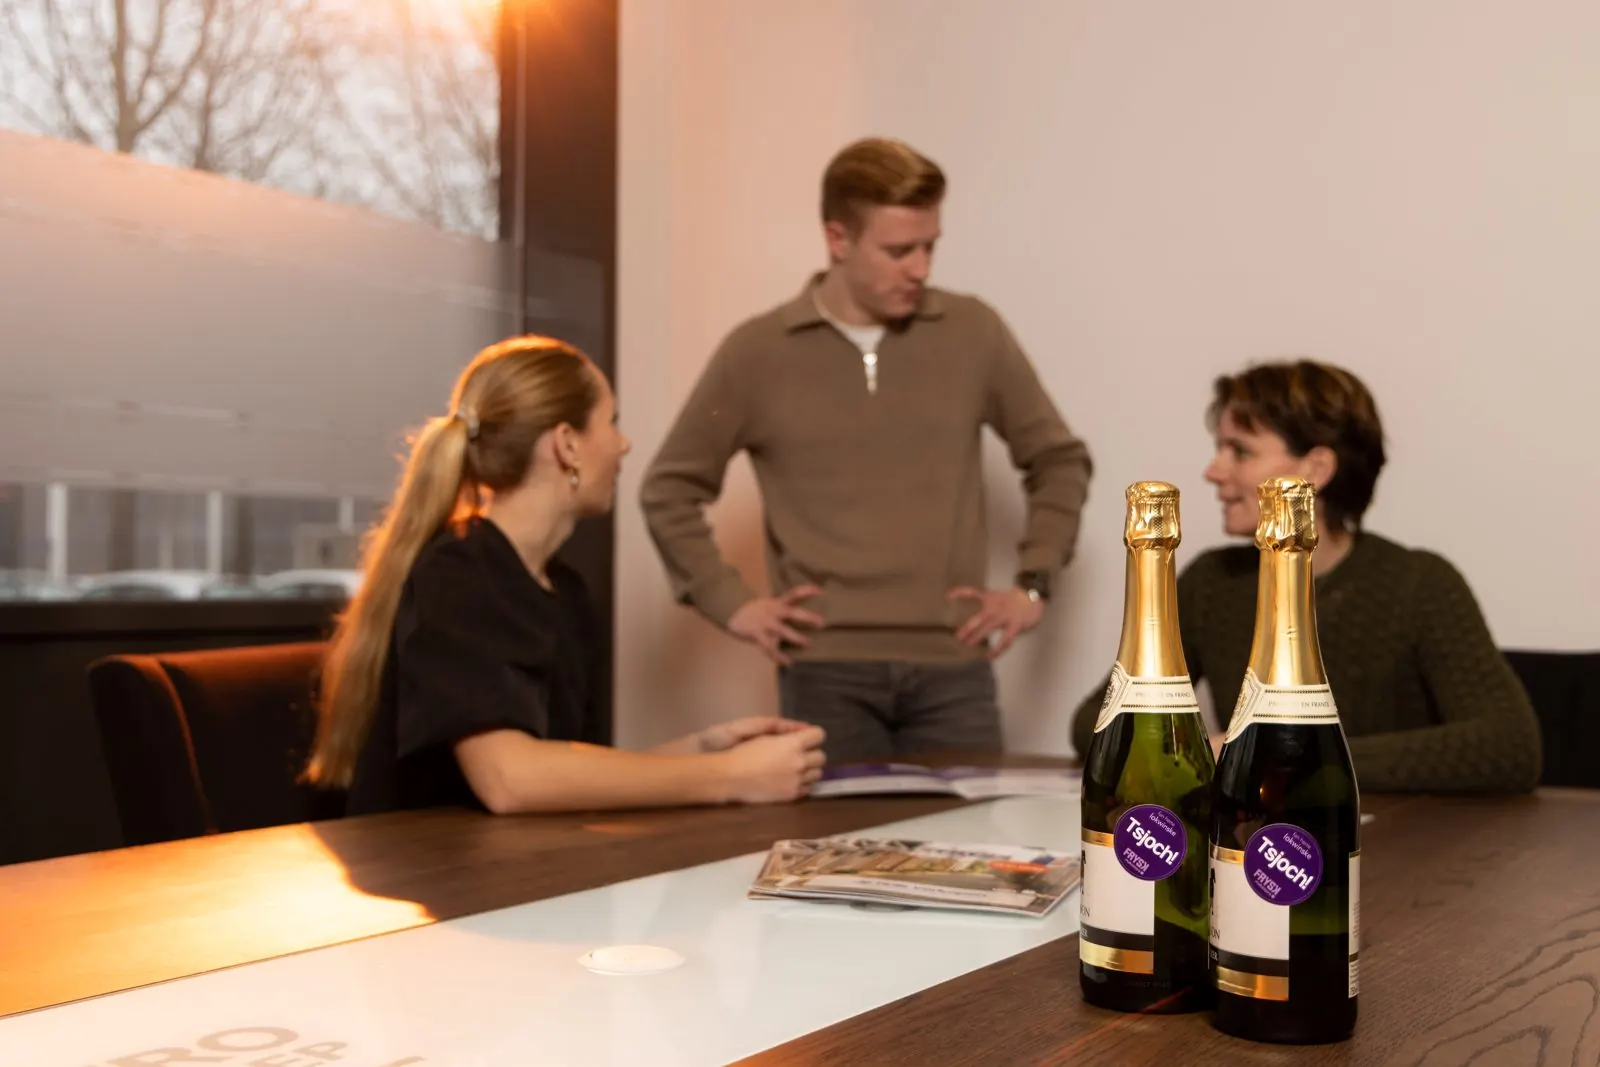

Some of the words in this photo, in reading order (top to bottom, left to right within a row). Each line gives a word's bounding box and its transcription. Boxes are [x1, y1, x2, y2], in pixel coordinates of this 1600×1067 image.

[1149, 812, 1177, 837] lokwinske
[1126, 816, 1180, 866] Tsjoch!
[1282, 832, 1312, 860] lokwinske
[1123, 847, 1150, 873] FRYSK
[1257, 836, 1314, 891] Tsjoch!
[1253, 868, 1282, 896] FRYSK
